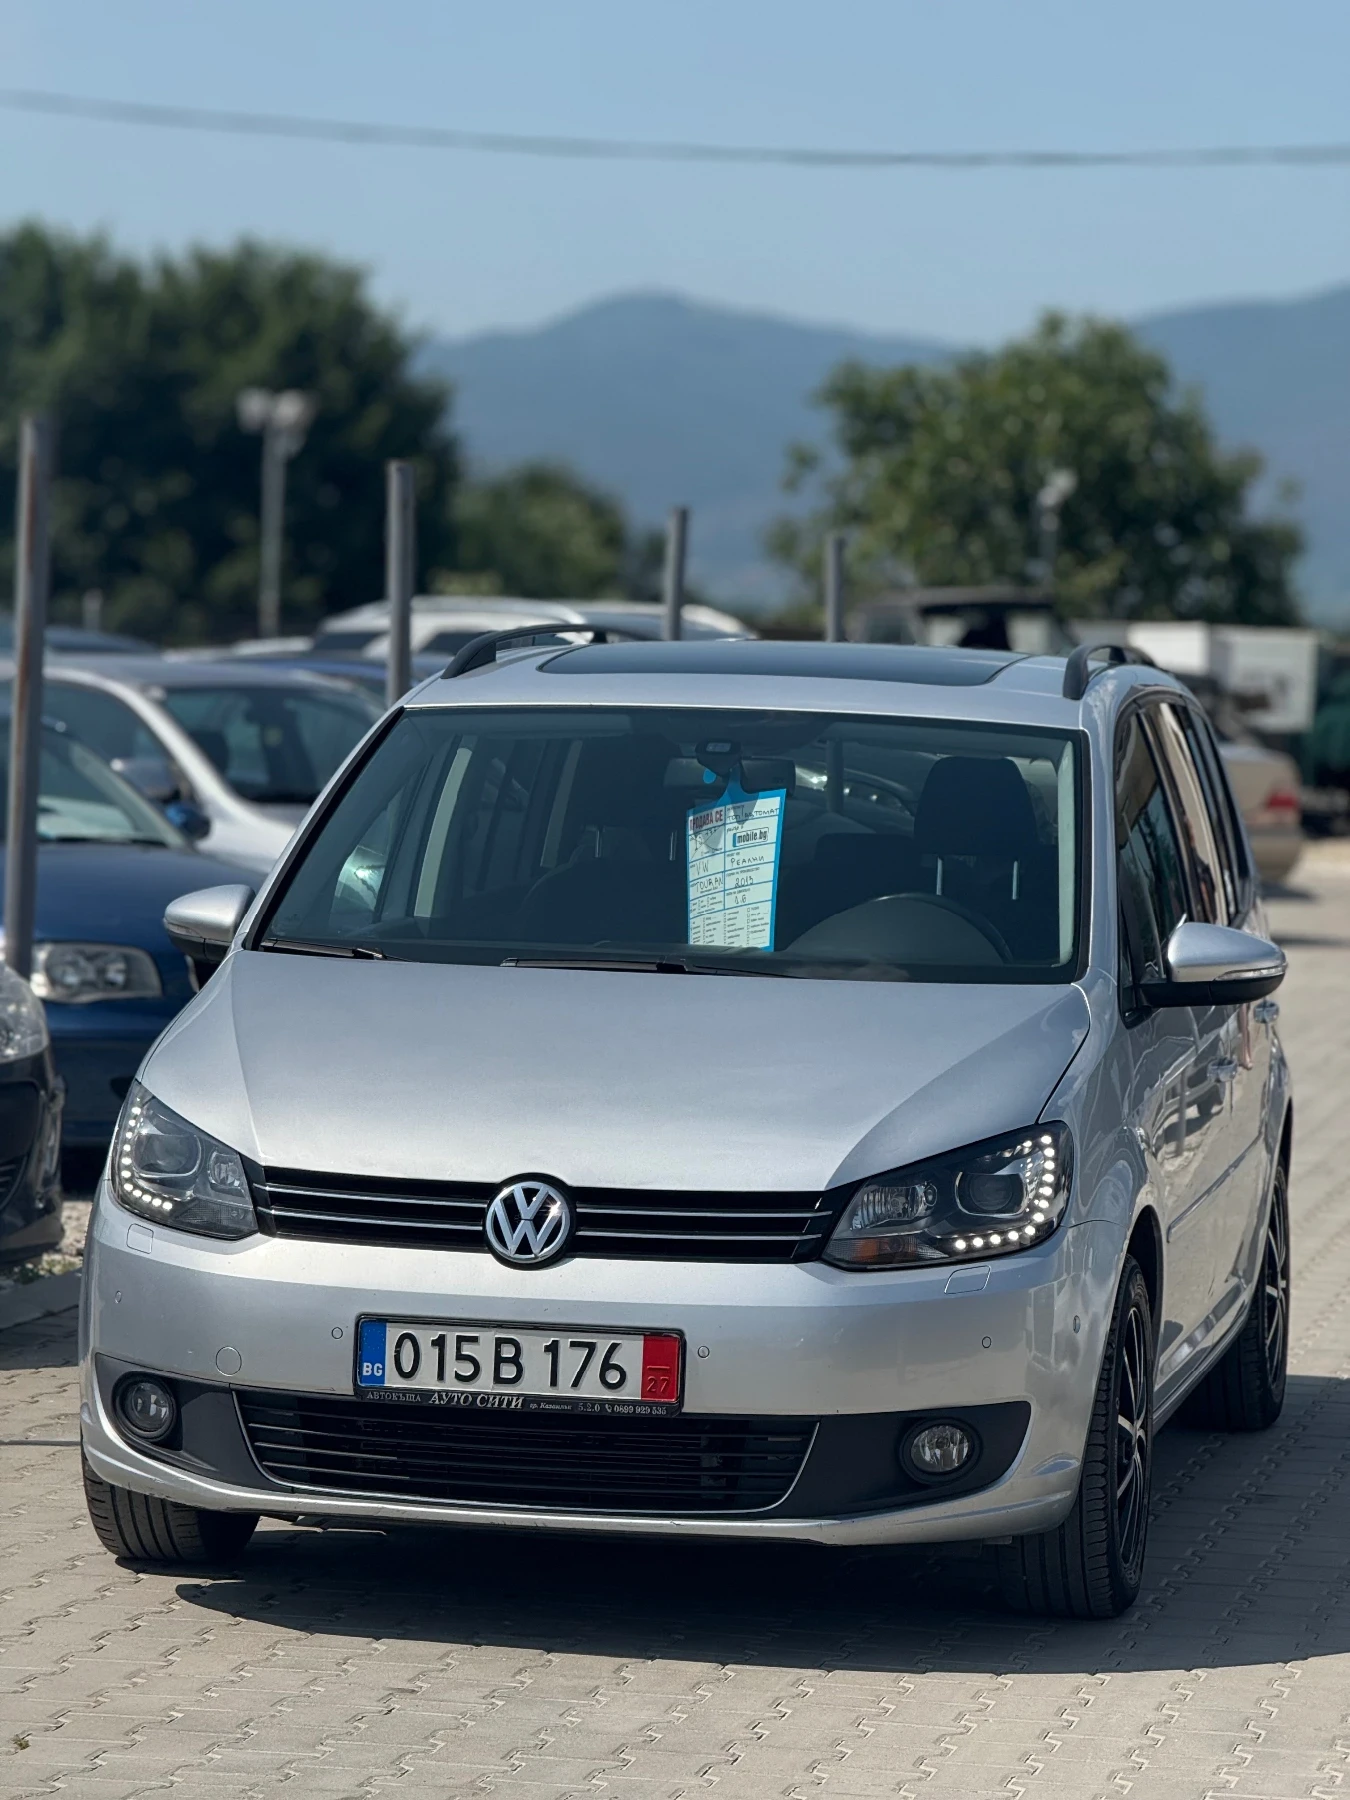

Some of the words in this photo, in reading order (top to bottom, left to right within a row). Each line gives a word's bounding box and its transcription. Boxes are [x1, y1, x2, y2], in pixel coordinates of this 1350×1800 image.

[715, 809, 723, 822] СЕ
[736, 829, 767, 843] mobile.bg
[696, 860, 709, 876] VW
[696, 873, 723, 892] TOURAN
[486, 1181, 570, 1263] VW
[394, 1331, 481, 1382] 015
[493, 1336, 523, 1384] B
[543, 1339, 627, 1390] 176
[362, 1362, 383, 1376] BG
[646, 1376, 670, 1392] 27
[366, 1391, 421, 1401] АВТОКЪЩА
[429, 1392, 472, 1405] АУТО
[476, 1393, 524, 1409] СИТИ
